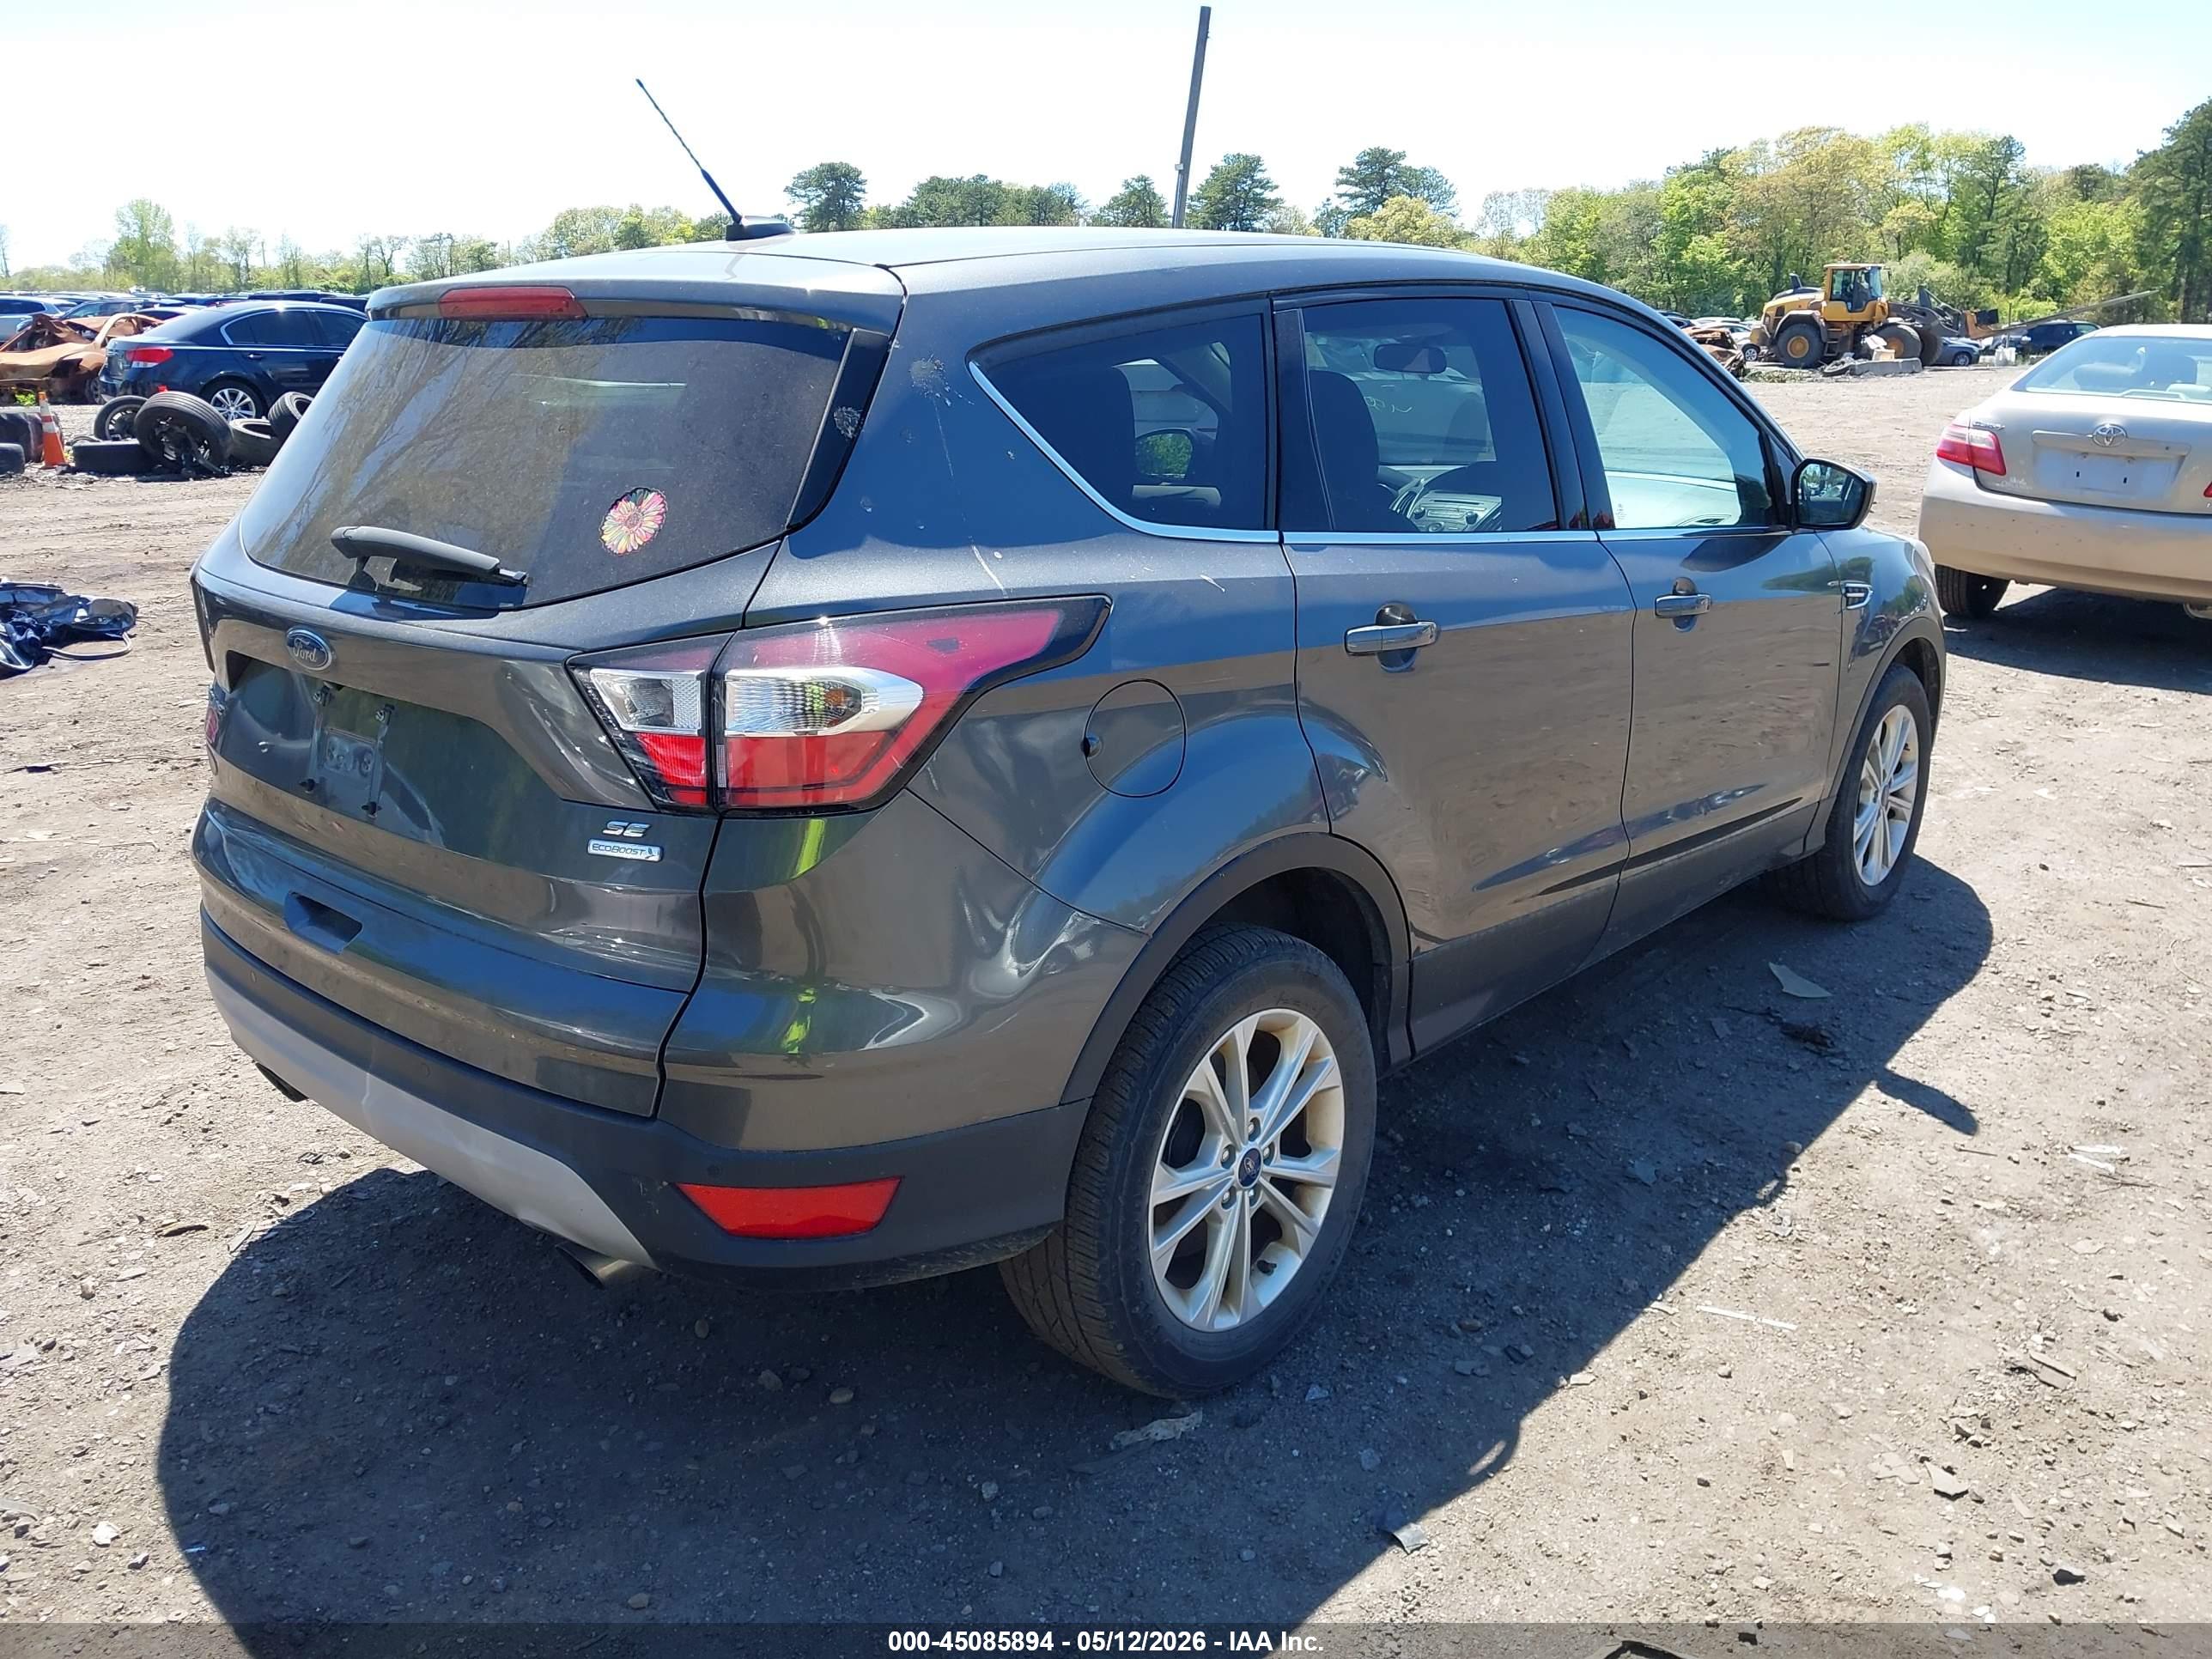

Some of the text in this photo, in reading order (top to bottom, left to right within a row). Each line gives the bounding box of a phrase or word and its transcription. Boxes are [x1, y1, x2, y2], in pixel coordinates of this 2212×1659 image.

[294, 637, 317, 662] Ford
[602, 821, 651, 837] SE
[592, 843, 647, 856] ECOBOOST
